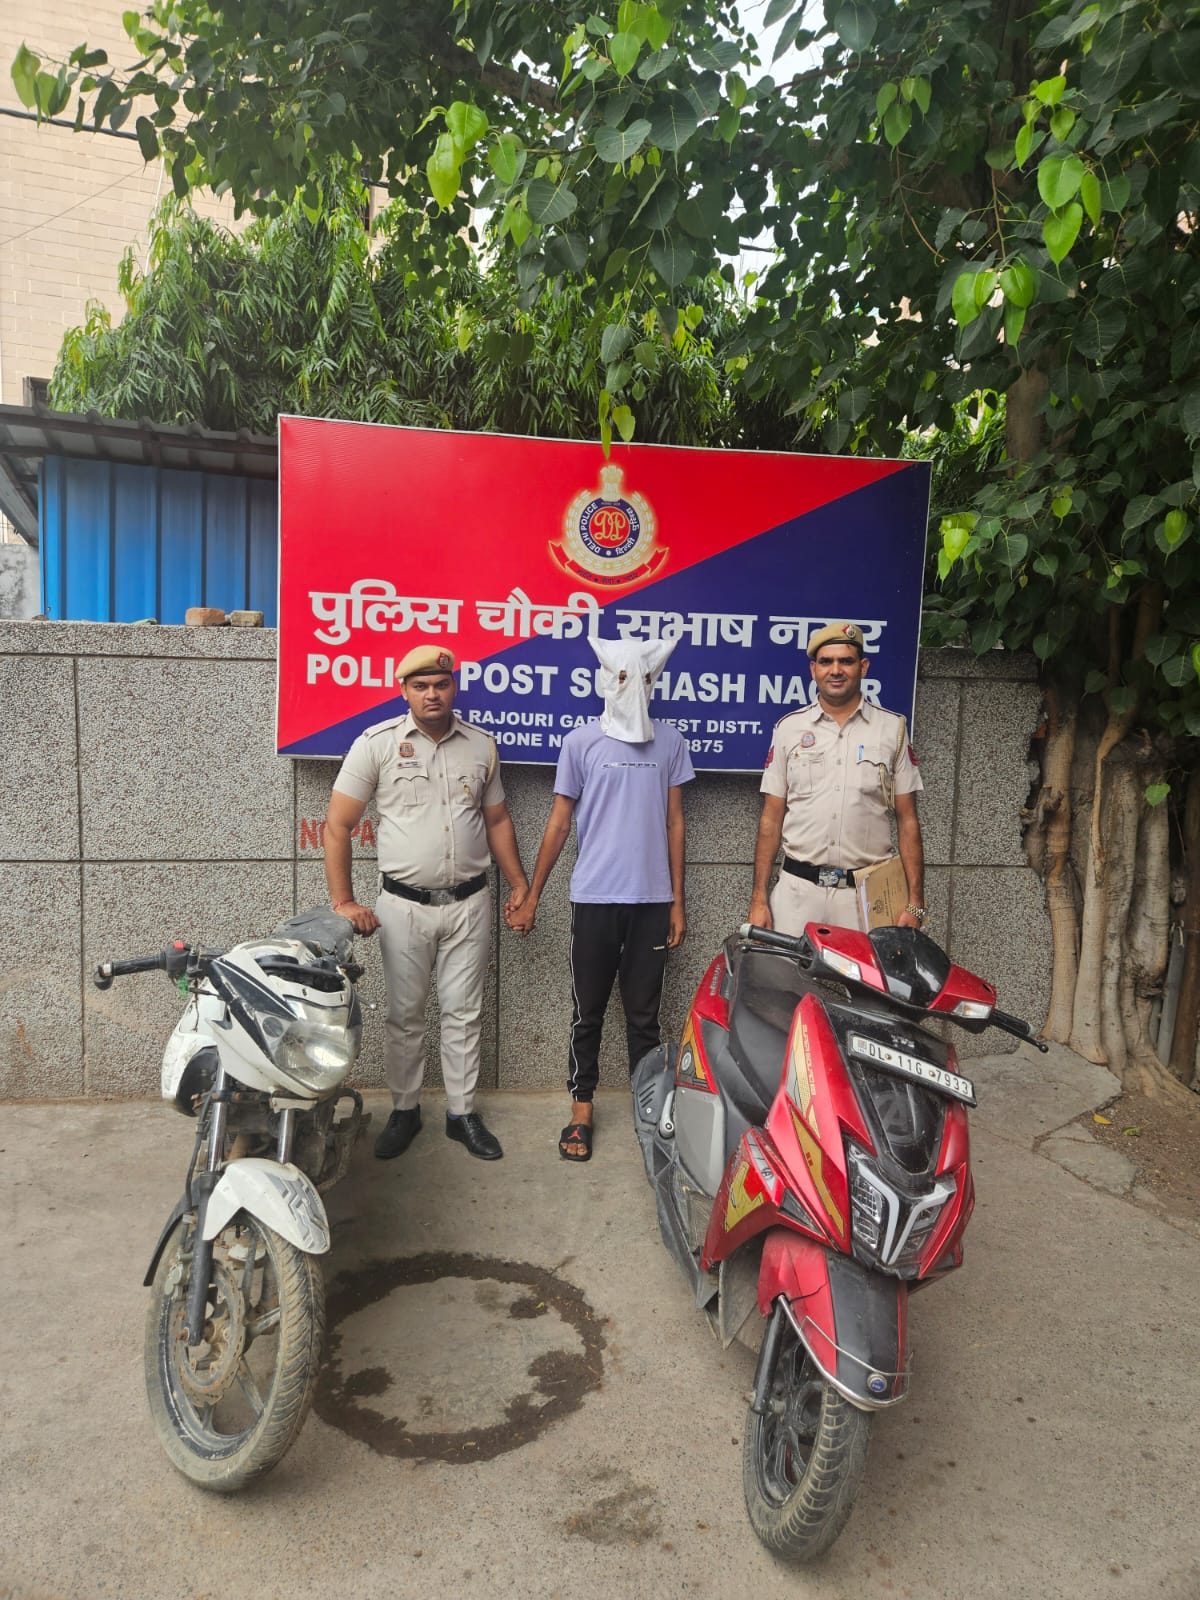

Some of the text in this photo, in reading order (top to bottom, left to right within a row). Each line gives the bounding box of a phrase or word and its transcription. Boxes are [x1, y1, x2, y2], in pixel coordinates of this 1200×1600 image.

[580, 502, 601, 554] DELHI POLICE
[308, 578, 463, 645] पुलिस
[475, 587, 604, 639] चौकी
[769, 615, 888, 654] नर
[306, 653, 882, 707] POLI POST SHASH NAR
[469, 709, 554, 727] RAJOURI
[706, 720, 763, 735] DISTT.
[490, 731, 543, 747] HONE
[869, 1043, 969, 1095] DL 11G 7933
